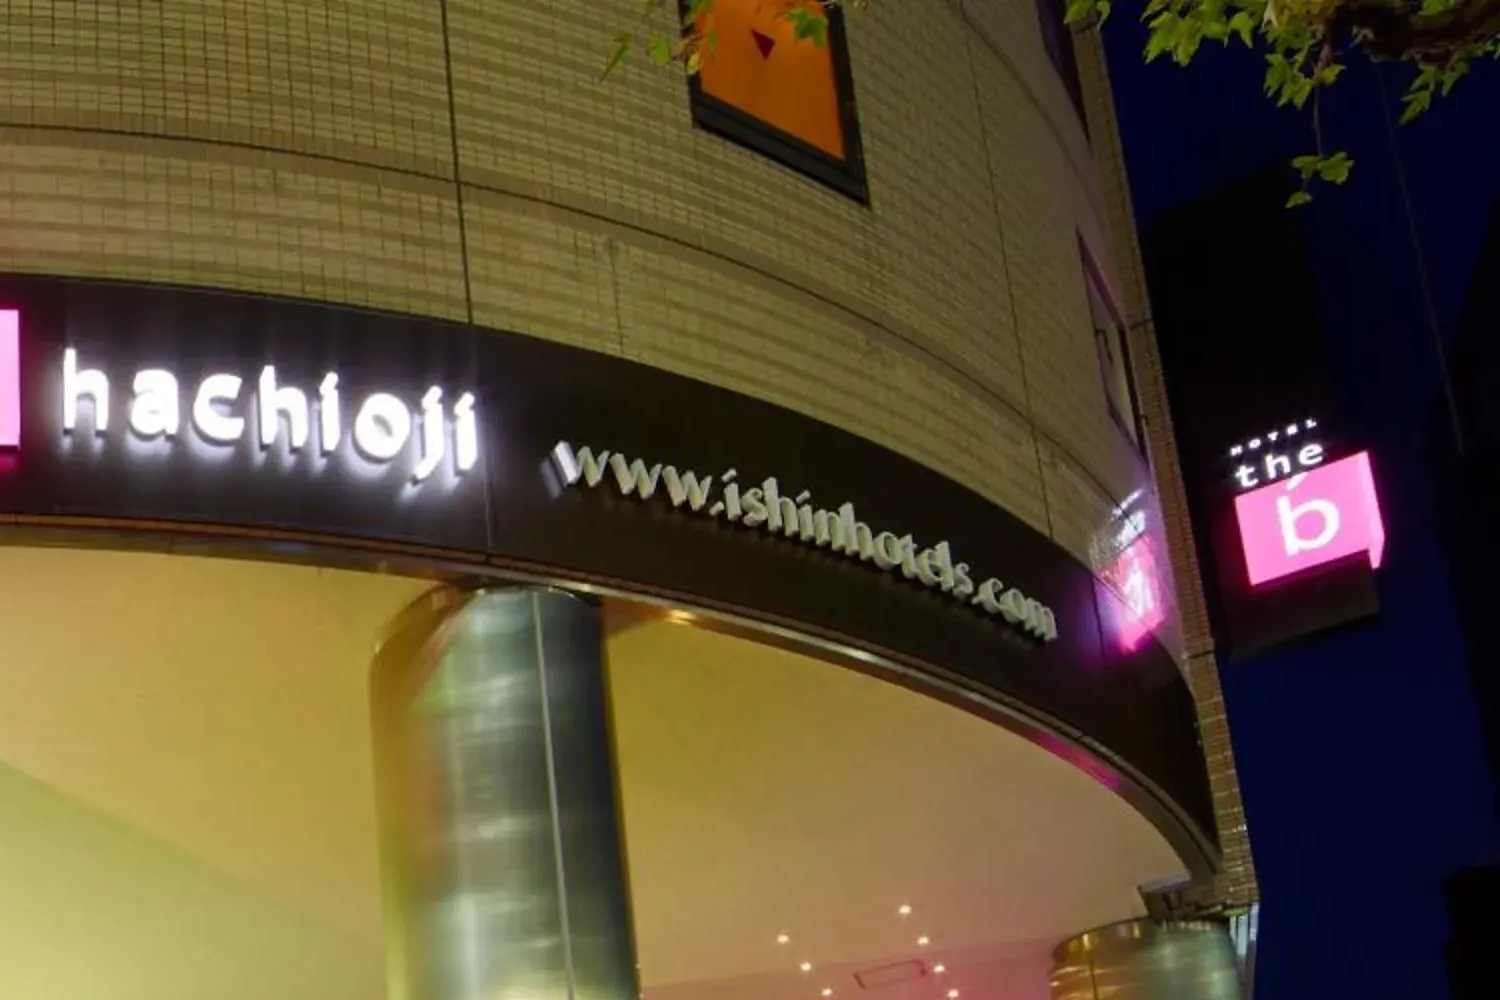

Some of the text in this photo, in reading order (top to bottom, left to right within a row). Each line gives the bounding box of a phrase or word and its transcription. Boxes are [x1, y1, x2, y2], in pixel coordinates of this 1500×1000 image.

[62, 346, 479, 484] hachioji
[1229, 417, 1318, 457] HOTEL
[1235, 442, 1324, 488] the
[543, 440, 1058, 642] www.ishinhotels.com
